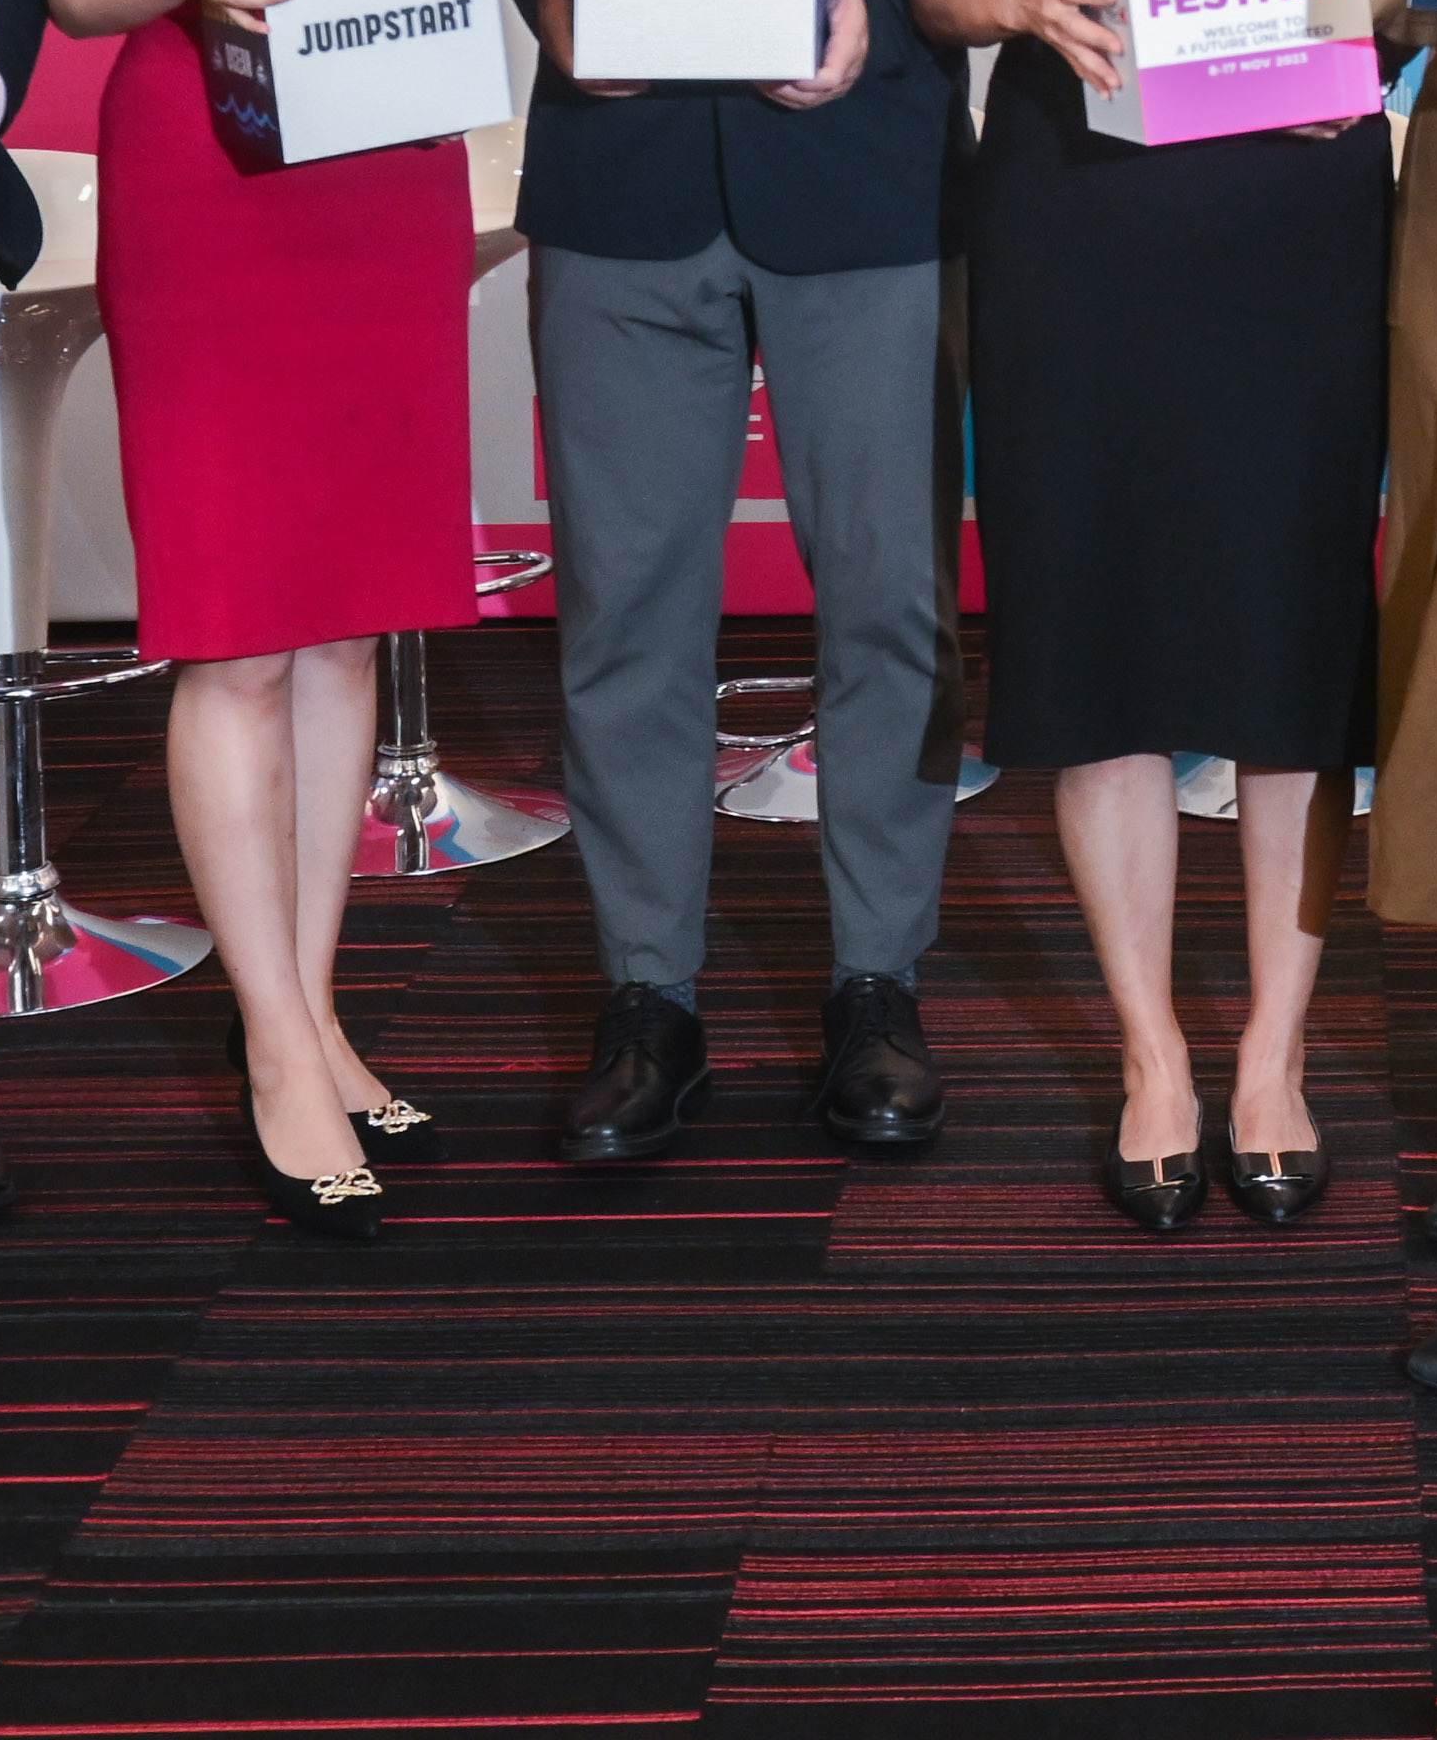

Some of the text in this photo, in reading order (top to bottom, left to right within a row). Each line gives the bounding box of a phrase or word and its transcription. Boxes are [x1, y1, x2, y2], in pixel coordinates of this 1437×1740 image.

[1191, 37, 1247, 55] FUTURE
[1253, 25, 1333, 46] UNLIMITED
[1203, 16, 1304, 38] WELCOME TO
